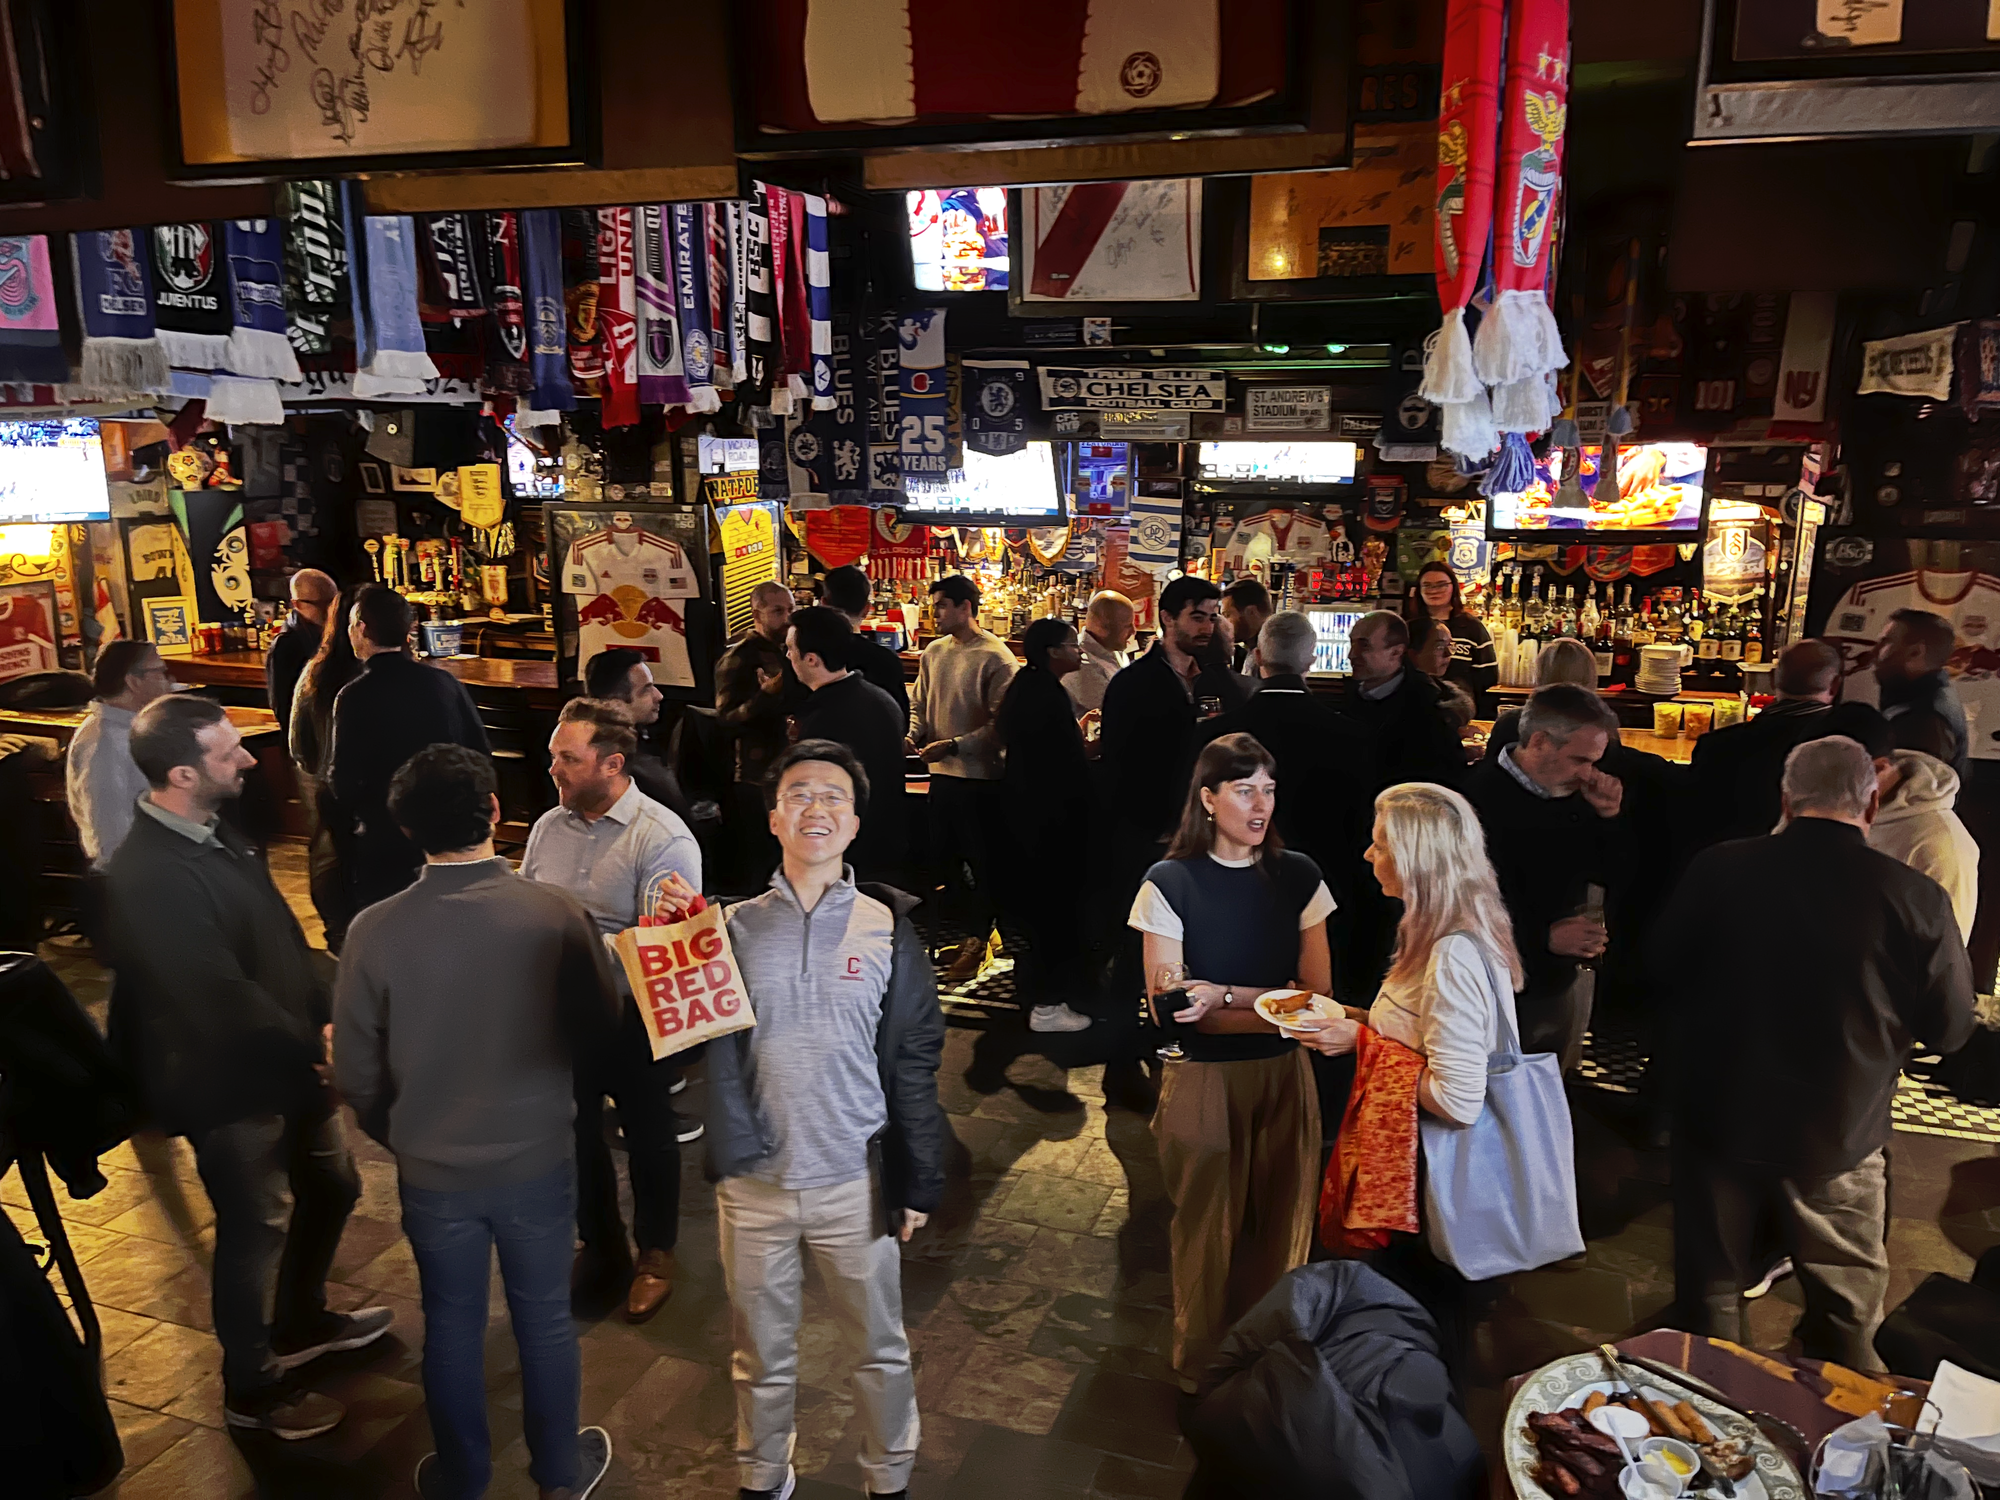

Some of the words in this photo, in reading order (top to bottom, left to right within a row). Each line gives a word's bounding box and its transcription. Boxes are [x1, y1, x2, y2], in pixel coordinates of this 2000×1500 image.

[831, 333, 855, 426] BLUES
[1086, 381, 1213, 399] CHELSEA
[1270, 390, 1324, 403] ANDREW'S
[1086, 398, 1165, 409] FOOTBALL
[1253, 404, 1298, 417] STADIUM
[900, 415, 946, 454] 25
[901, 455, 947, 472] YEARS
[637, 926, 724, 979] BIG
[846, 957, 861, 975] C
[645, 959, 733, 1010] RED
[652, 987, 742, 1039] BAG
